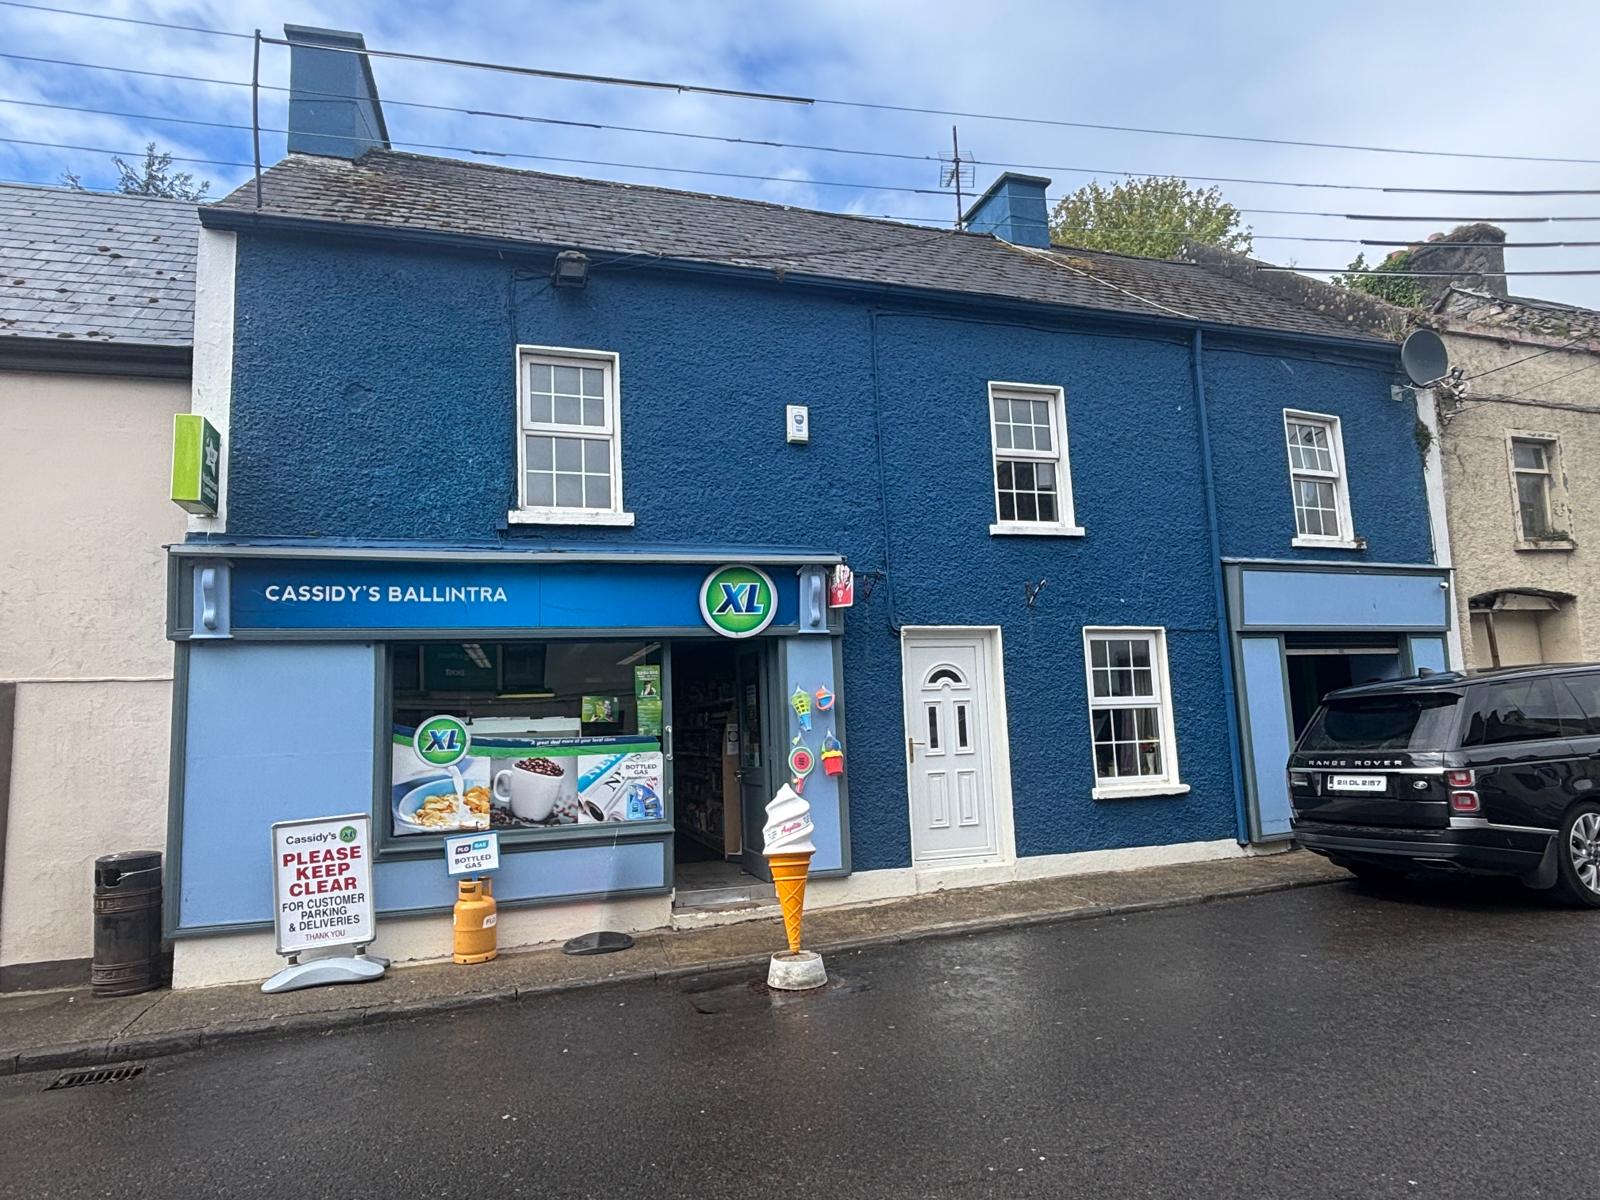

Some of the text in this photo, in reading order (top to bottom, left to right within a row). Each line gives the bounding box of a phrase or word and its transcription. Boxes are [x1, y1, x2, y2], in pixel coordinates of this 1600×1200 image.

[265, 585, 508, 602] CASSIDY'S BALLINTRA
[712, 582, 765, 615] XL
[422, 729, 461, 752] XL
[286, 832, 337, 845] Cassidy's
[283, 845, 362, 867] PLEASE
[455, 854, 492, 865] BOTTLED
[296, 862, 350, 881] KEEP
[289, 877, 357, 897] CLEAR
[282, 893, 365, 912] FOR CUSTOMER
[301, 906, 347, 920] PARKING
[289, 914, 360, 932] & DELIVERIES
[305, 929, 346, 941] THANK YOU
